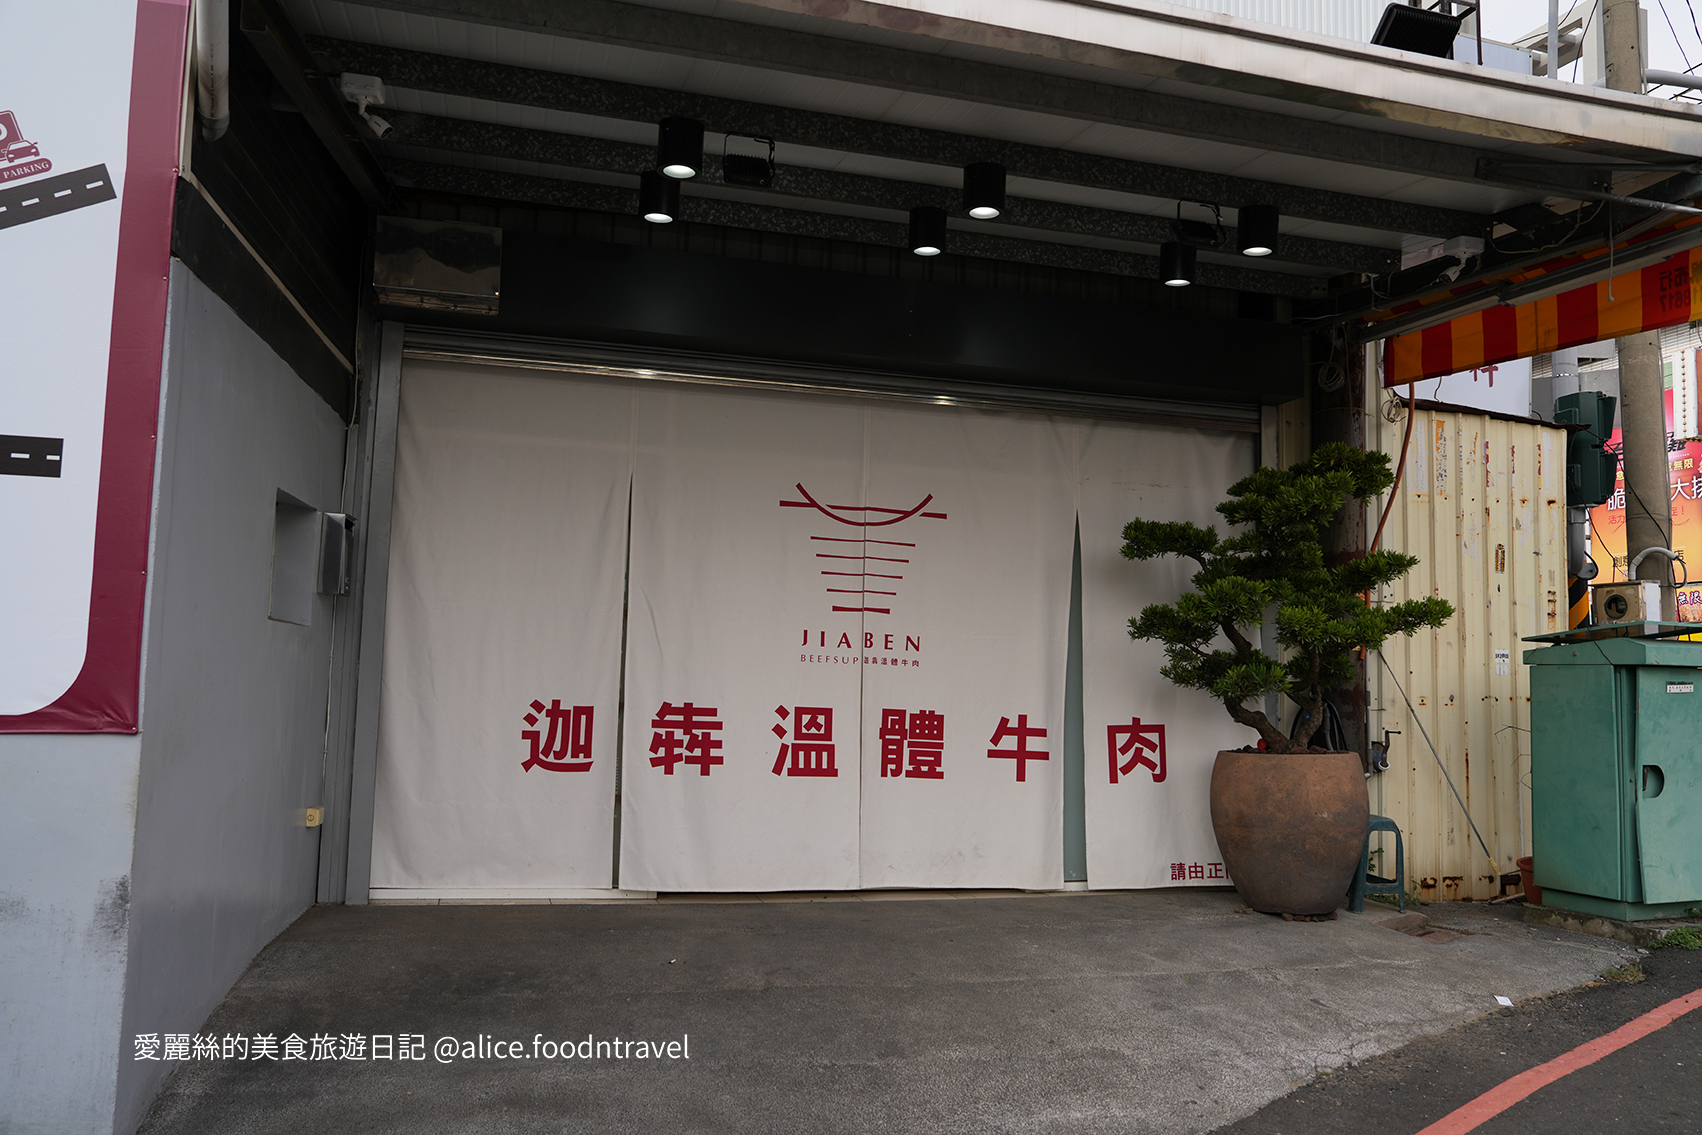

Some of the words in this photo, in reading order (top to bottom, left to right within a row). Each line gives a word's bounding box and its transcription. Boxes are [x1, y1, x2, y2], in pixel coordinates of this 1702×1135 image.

[3, 161, 50, 179] PARKING
[801, 629, 921, 652] JIABEN
[1170, 862, 1229, 881] 請由正
